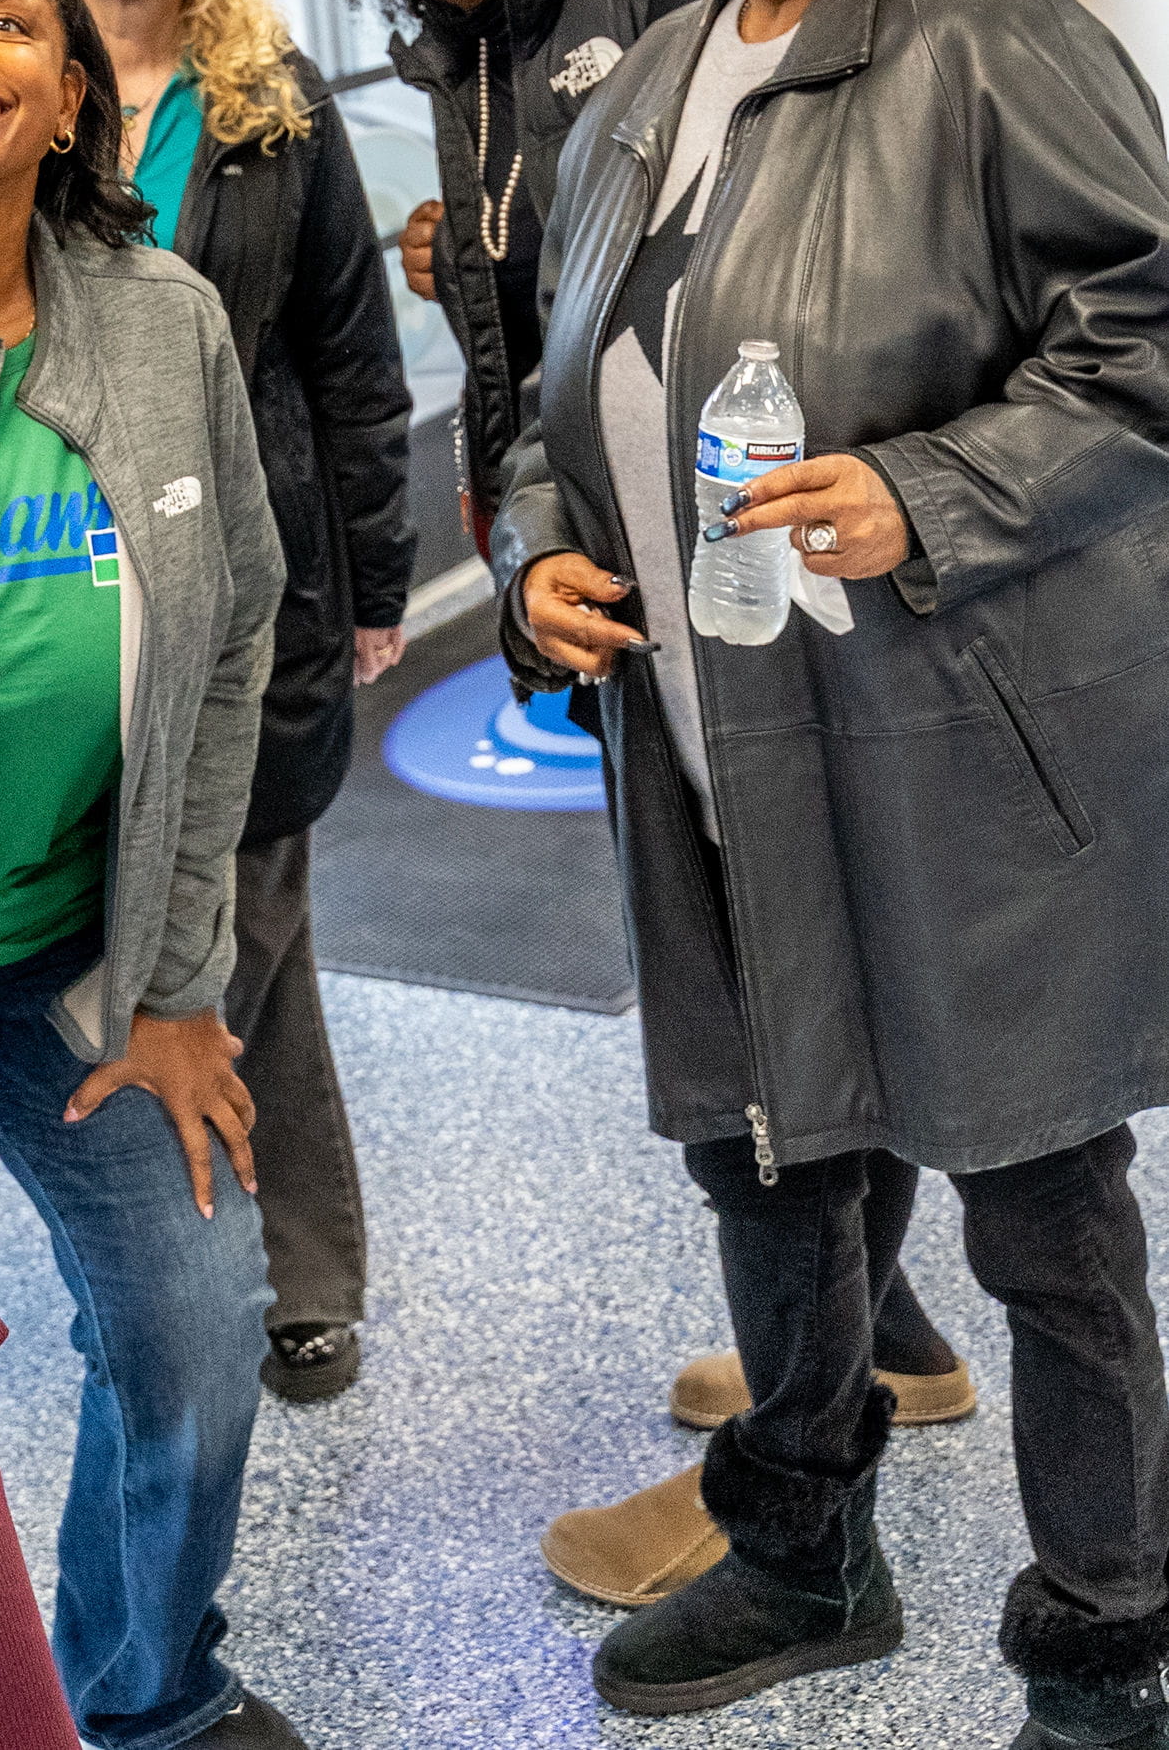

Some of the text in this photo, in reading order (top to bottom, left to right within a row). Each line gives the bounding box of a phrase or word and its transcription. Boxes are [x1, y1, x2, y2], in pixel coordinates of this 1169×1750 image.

[564, 45, 592, 66] THE
[549, 59, 598, 92] NORTH
[567, 70, 602, 98] FACE
[748, 444, 796, 455] KIRKLAND
[162, 480, 185, 496] THE
[164, 500, 192, 518] FACE
